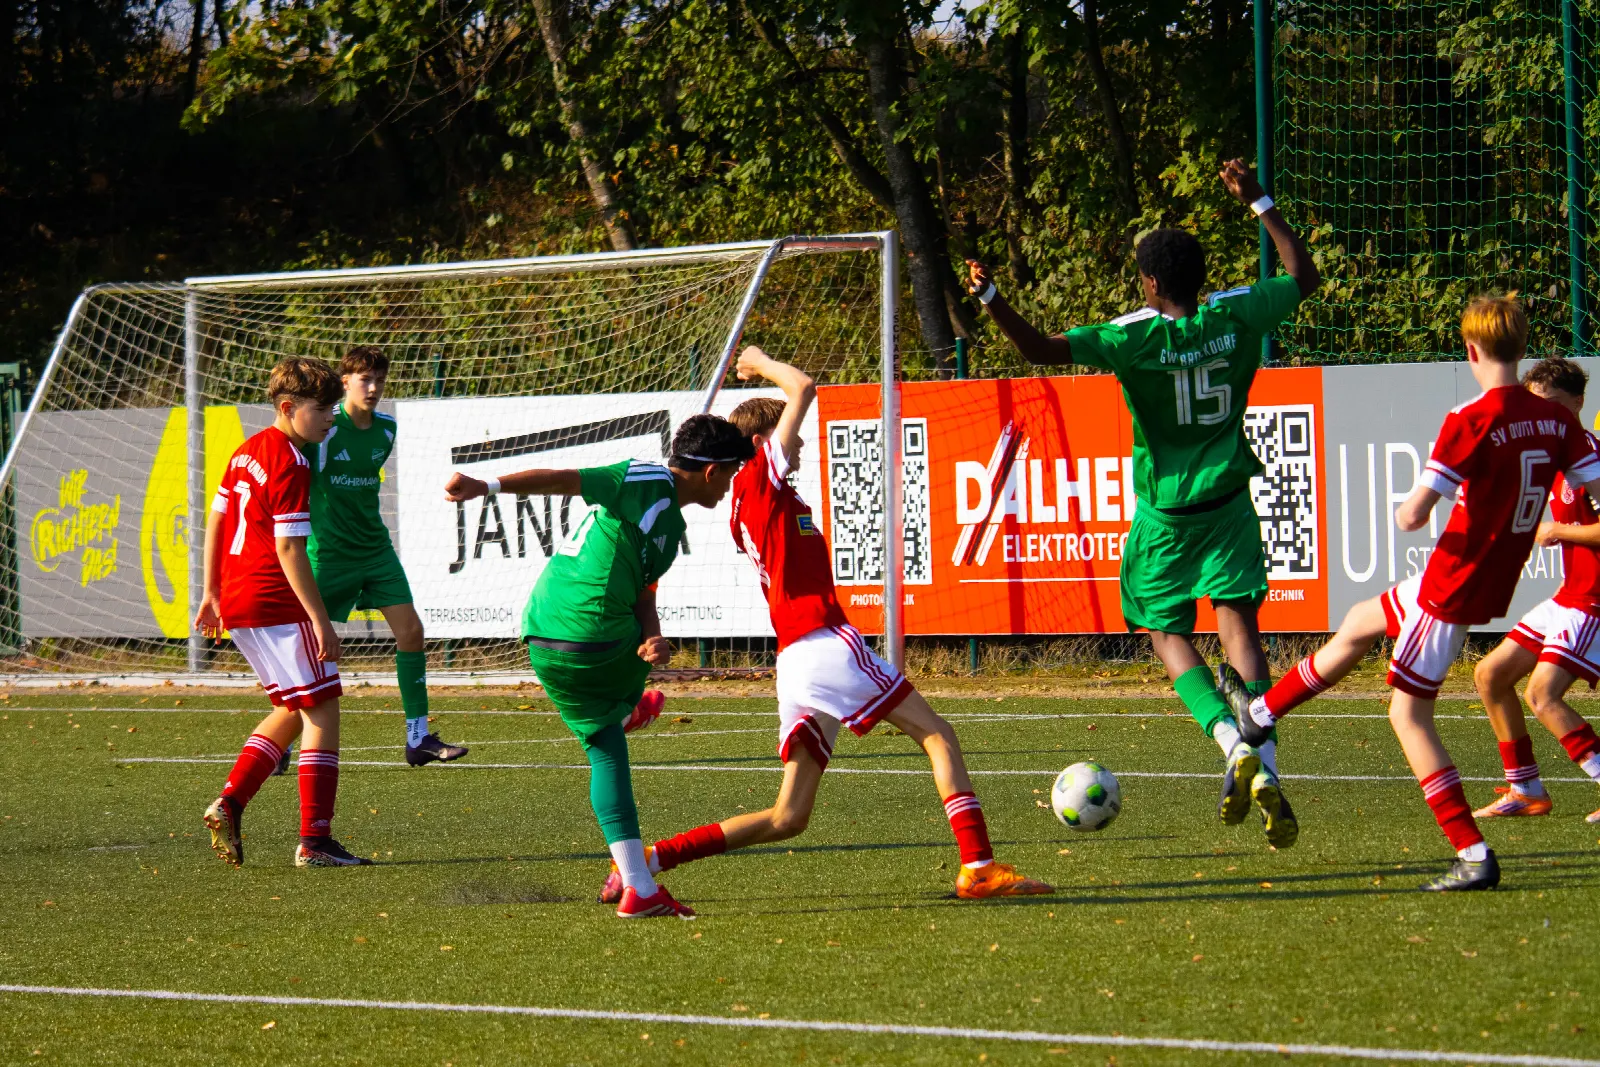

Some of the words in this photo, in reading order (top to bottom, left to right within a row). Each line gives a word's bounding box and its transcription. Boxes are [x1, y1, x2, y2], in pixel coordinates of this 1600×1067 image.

[1166, 358, 1232, 426] 15
[229, 480, 252, 556] 7
[955, 456, 1134, 525] DALHE
[1511, 449, 1551, 534] 6
